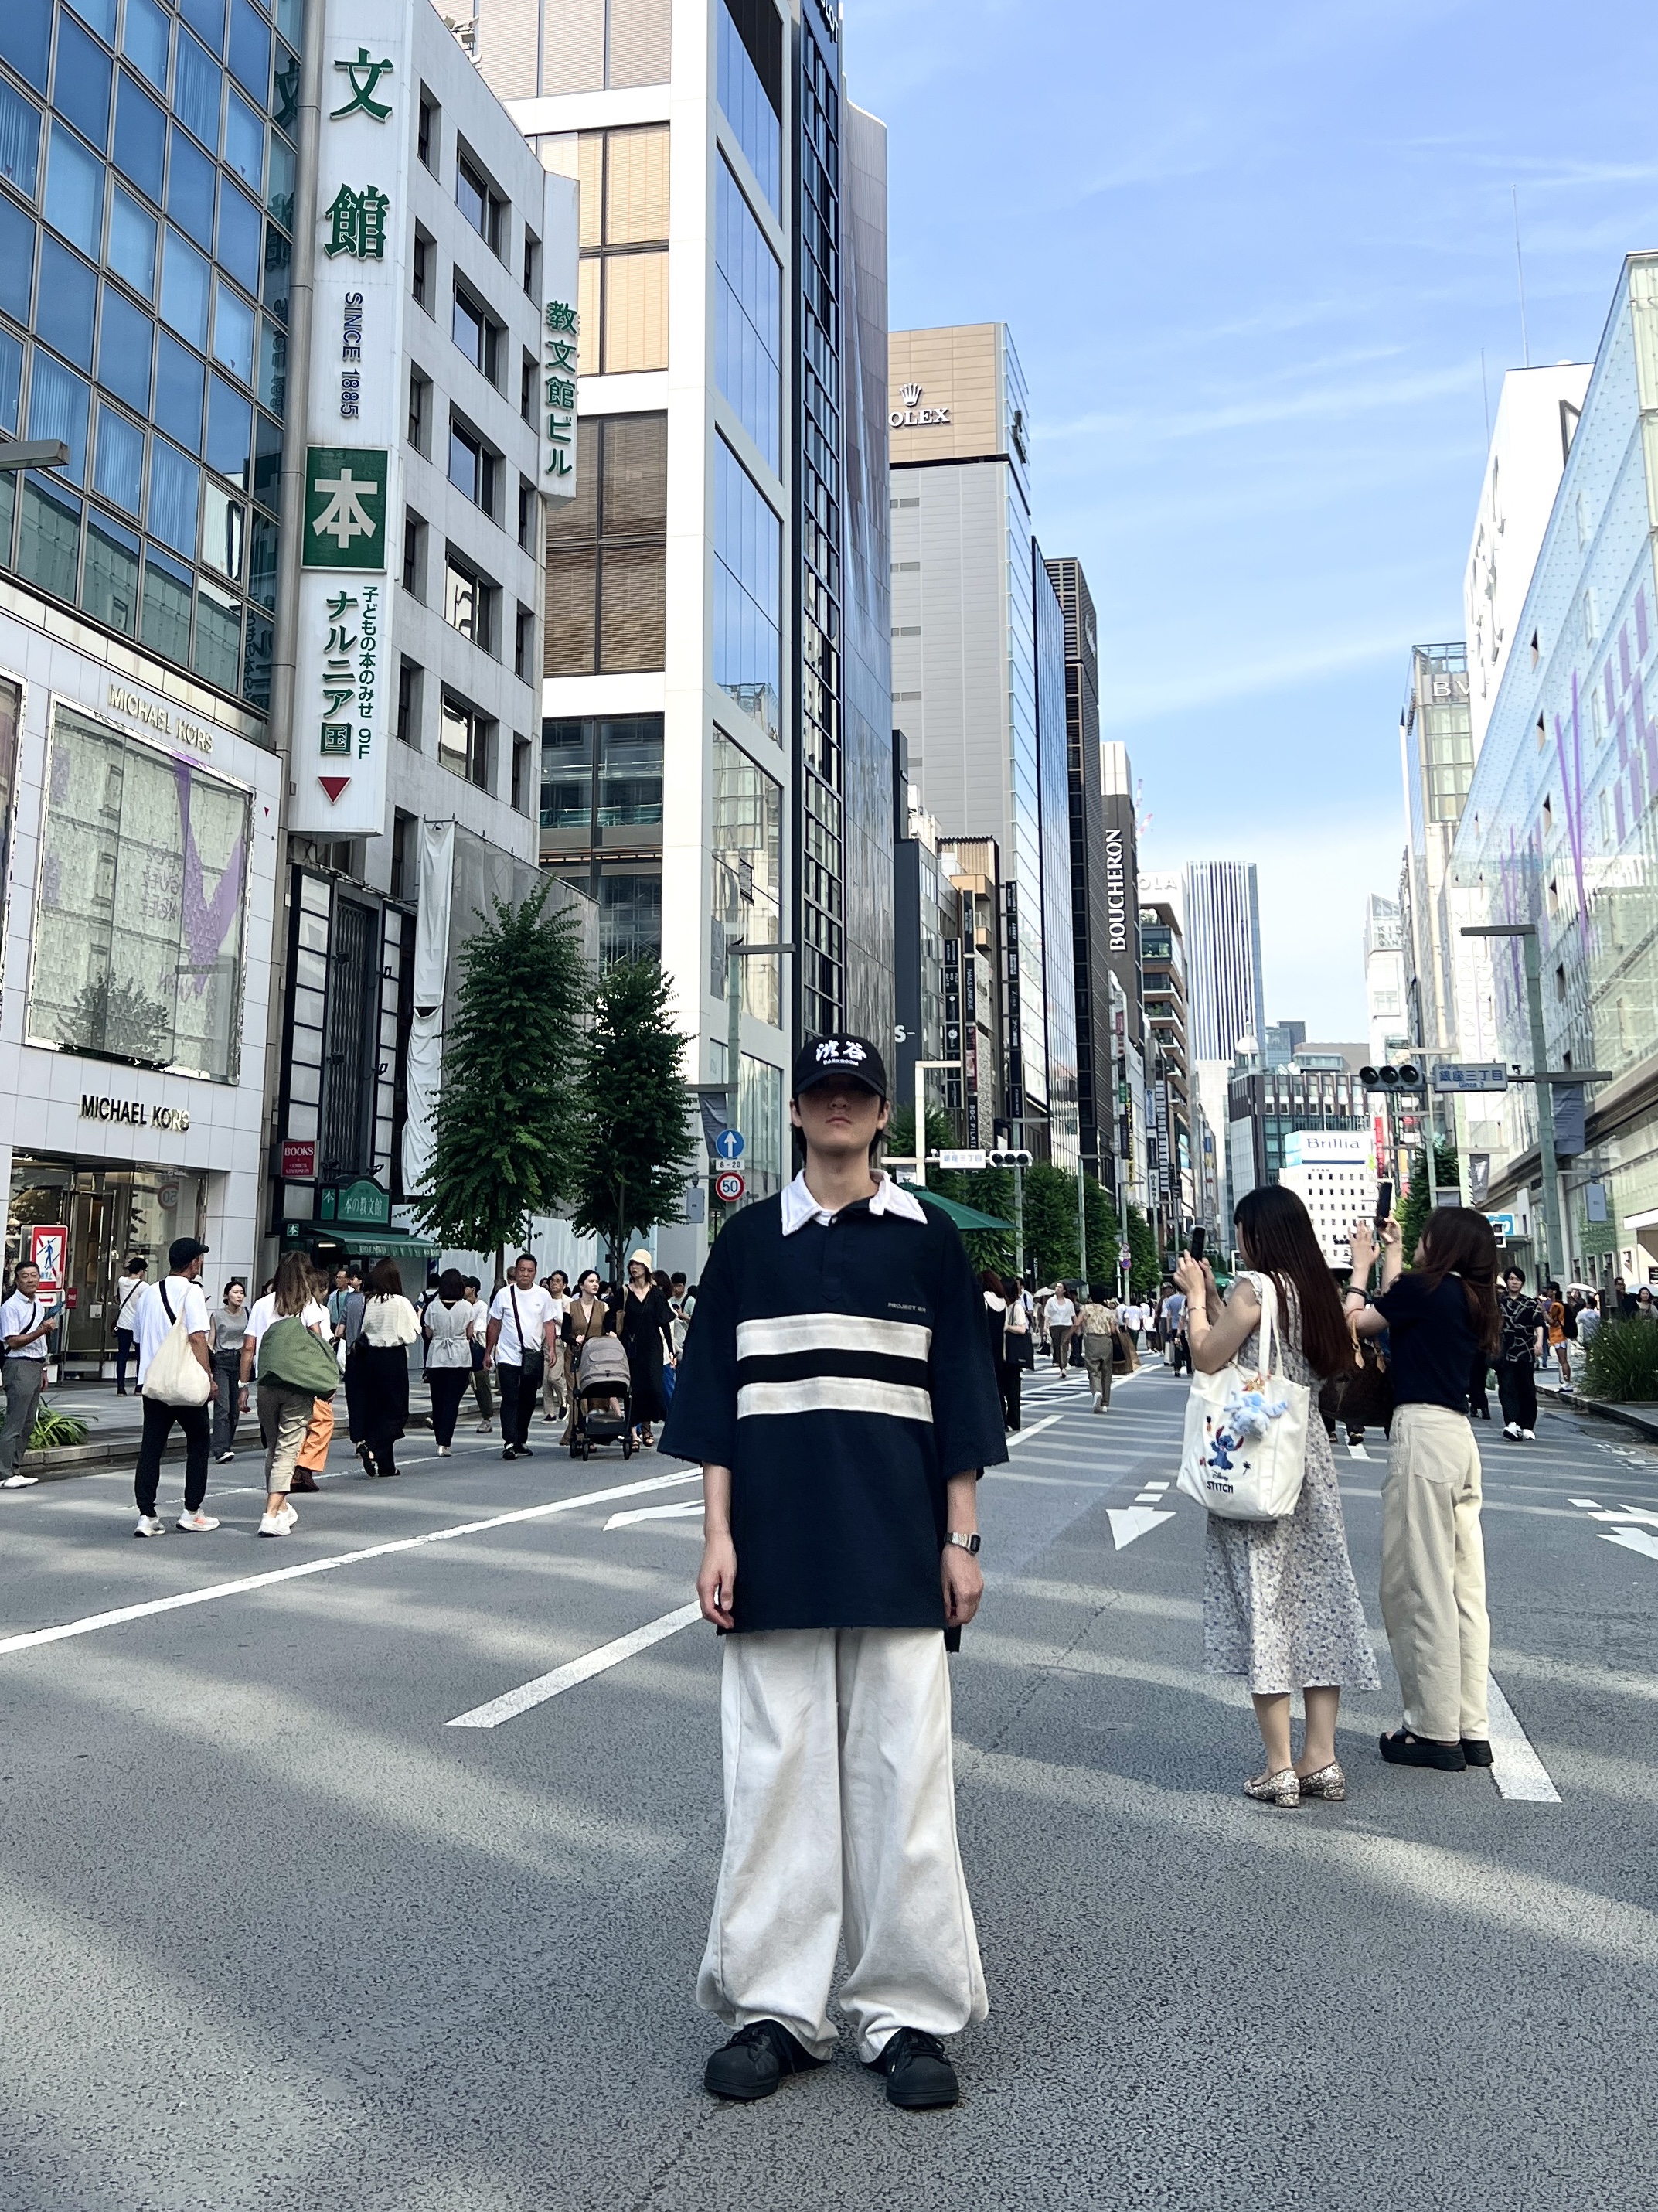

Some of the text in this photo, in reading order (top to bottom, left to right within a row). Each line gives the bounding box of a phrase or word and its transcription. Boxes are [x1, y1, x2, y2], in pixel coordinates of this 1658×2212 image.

[322, 46, 393, 261] 文館
[340, 291, 363, 419] SINCE 1885
[545, 300, 577, 477] 教文館ビル
[312, 468, 379, 549] 本
[320, 590, 359, 755] ナルニア国
[358, 586, 379, 760] 子どもの本のみせ 9F
[108, 684, 214, 754] MICHAEL KORS
[1105, 830, 1127, 951] BOUCHERON
[815, 1040, 867, 1062] 渋谷
[1438, 1069, 1503, 1082] 銀座三丁目
[80, 1094, 190, 1132] MICHAEL KORS
[284, 1147, 314, 1157] BOOKS
[1306, 1138, 1360, 1149] Brillia
[323, 1190, 335, 1204] 本
[723, 1180, 738, 1193] 50
[344, 1195, 383, 1217] 本の教文館
[288, 1225, 298, 1235] 本
[1207, 1481, 1234, 1494] STITCH
